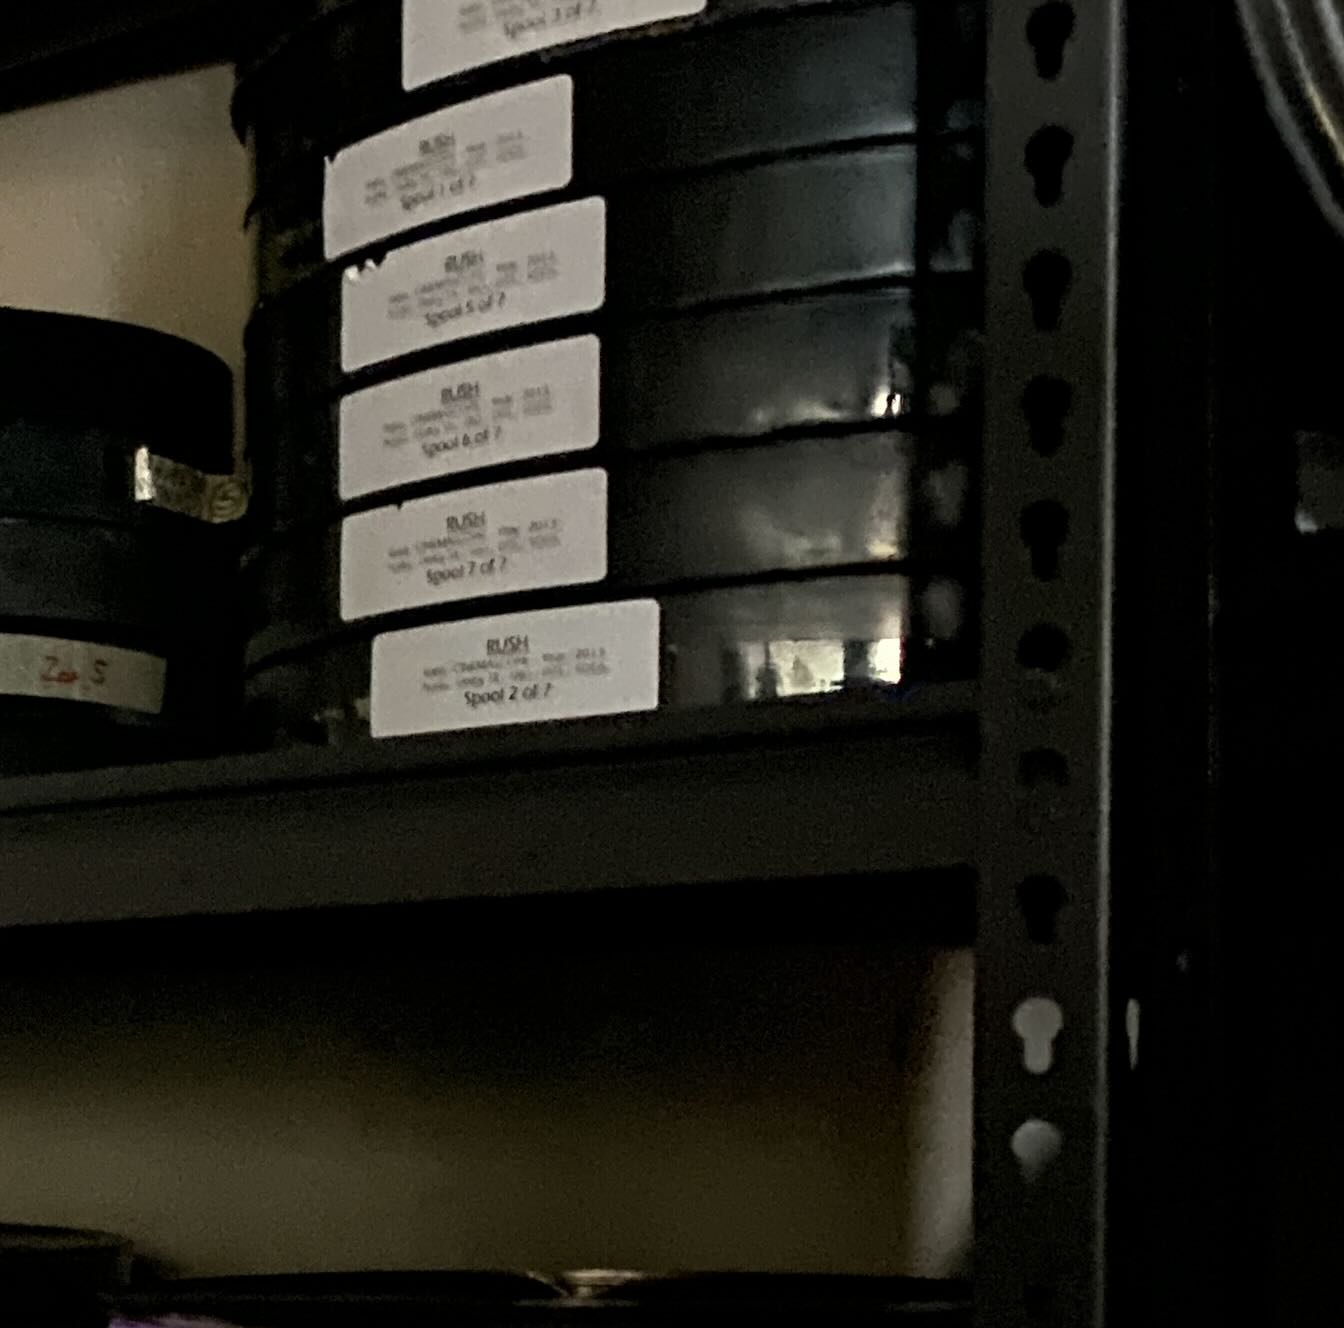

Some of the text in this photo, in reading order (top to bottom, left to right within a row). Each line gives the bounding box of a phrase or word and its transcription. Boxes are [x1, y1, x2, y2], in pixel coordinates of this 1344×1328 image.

[440, 383, 481, 402] RUSH
[446, 510, 488, 531] RUSH
[425, 556, 508, 585] Spool 7 of 7
[486, 634, 529, 654] RUSH
[93, 658, 110, 688] 5
[464, 683, 551, 706] Spool 2 of 7
